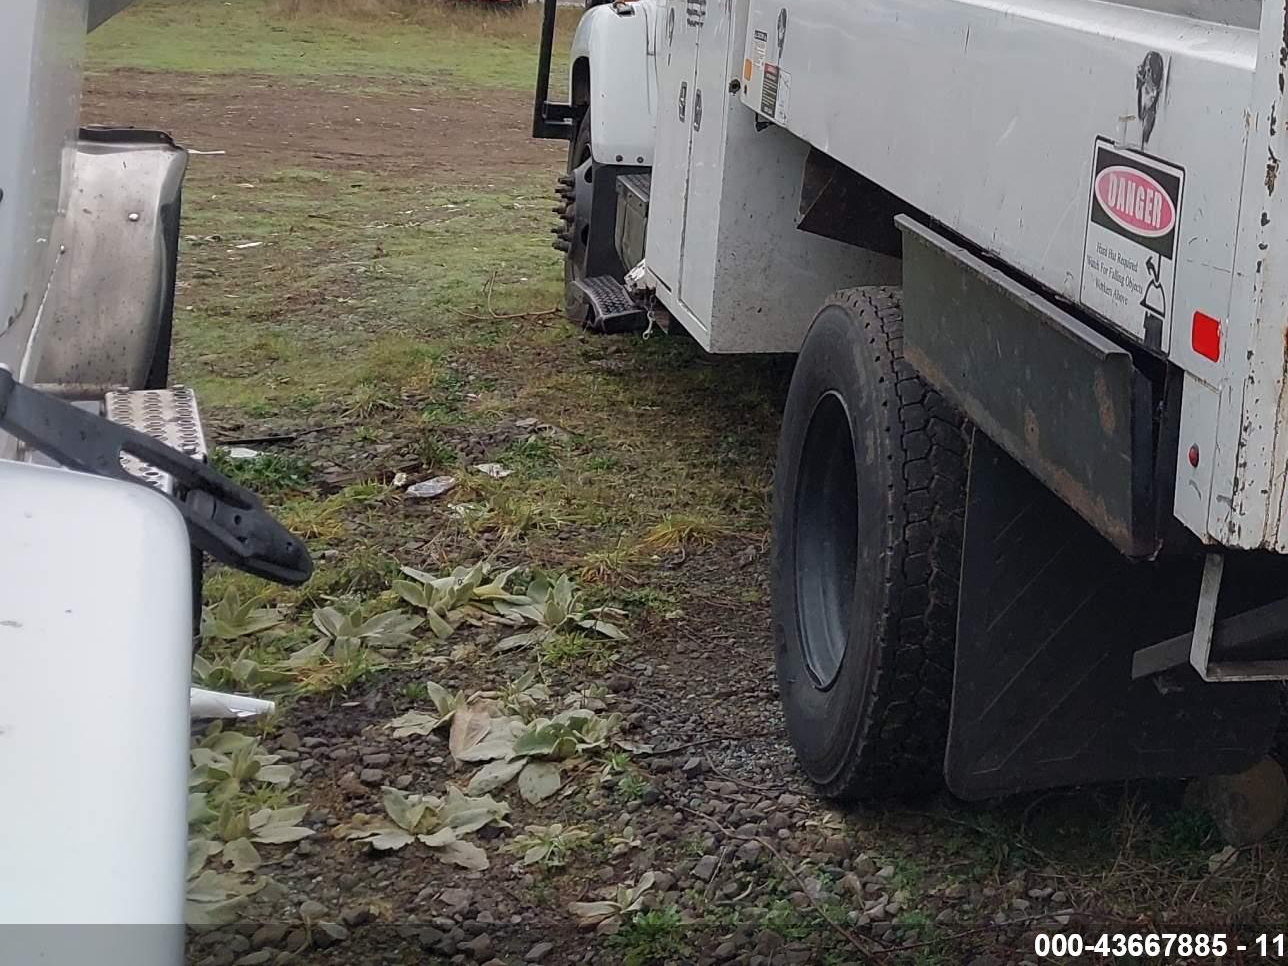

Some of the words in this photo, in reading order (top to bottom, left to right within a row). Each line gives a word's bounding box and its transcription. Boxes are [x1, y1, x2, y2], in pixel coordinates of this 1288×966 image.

[1108, 174, 1163, 230] DANGER
[1117, 252, 1138, 272] Required
[1109, 268, 1125, 287] Falling
[1126, 275, 1143, 294] Objects
